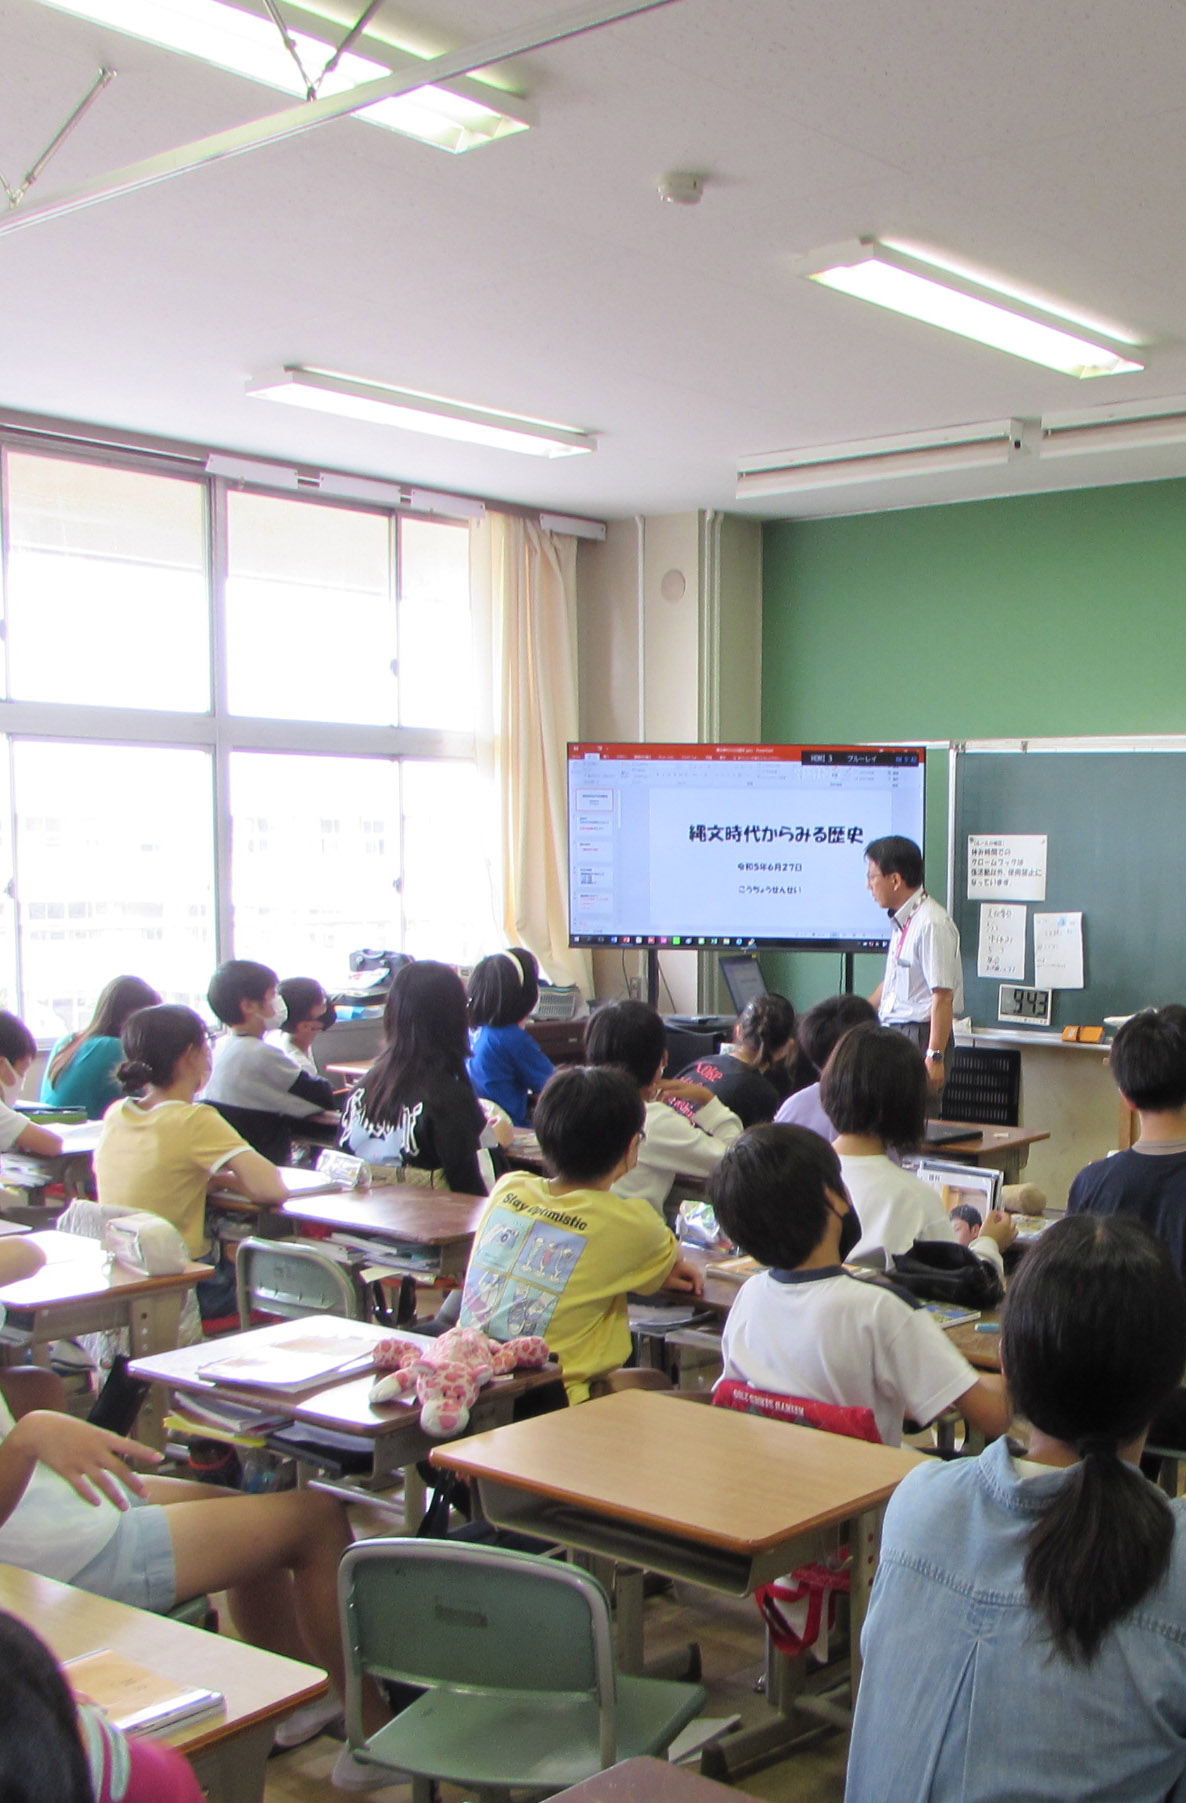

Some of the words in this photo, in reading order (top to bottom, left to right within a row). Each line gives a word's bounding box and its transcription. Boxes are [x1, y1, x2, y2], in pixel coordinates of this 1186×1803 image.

[689, 824, 864, 844] 縄文時代からみる歴史
[738, 863, 803, 872] 令和5年6月27日
[739, 885, 802, 895] こうちょうせんせい
[503, 1193, 529, 1212] Stay
